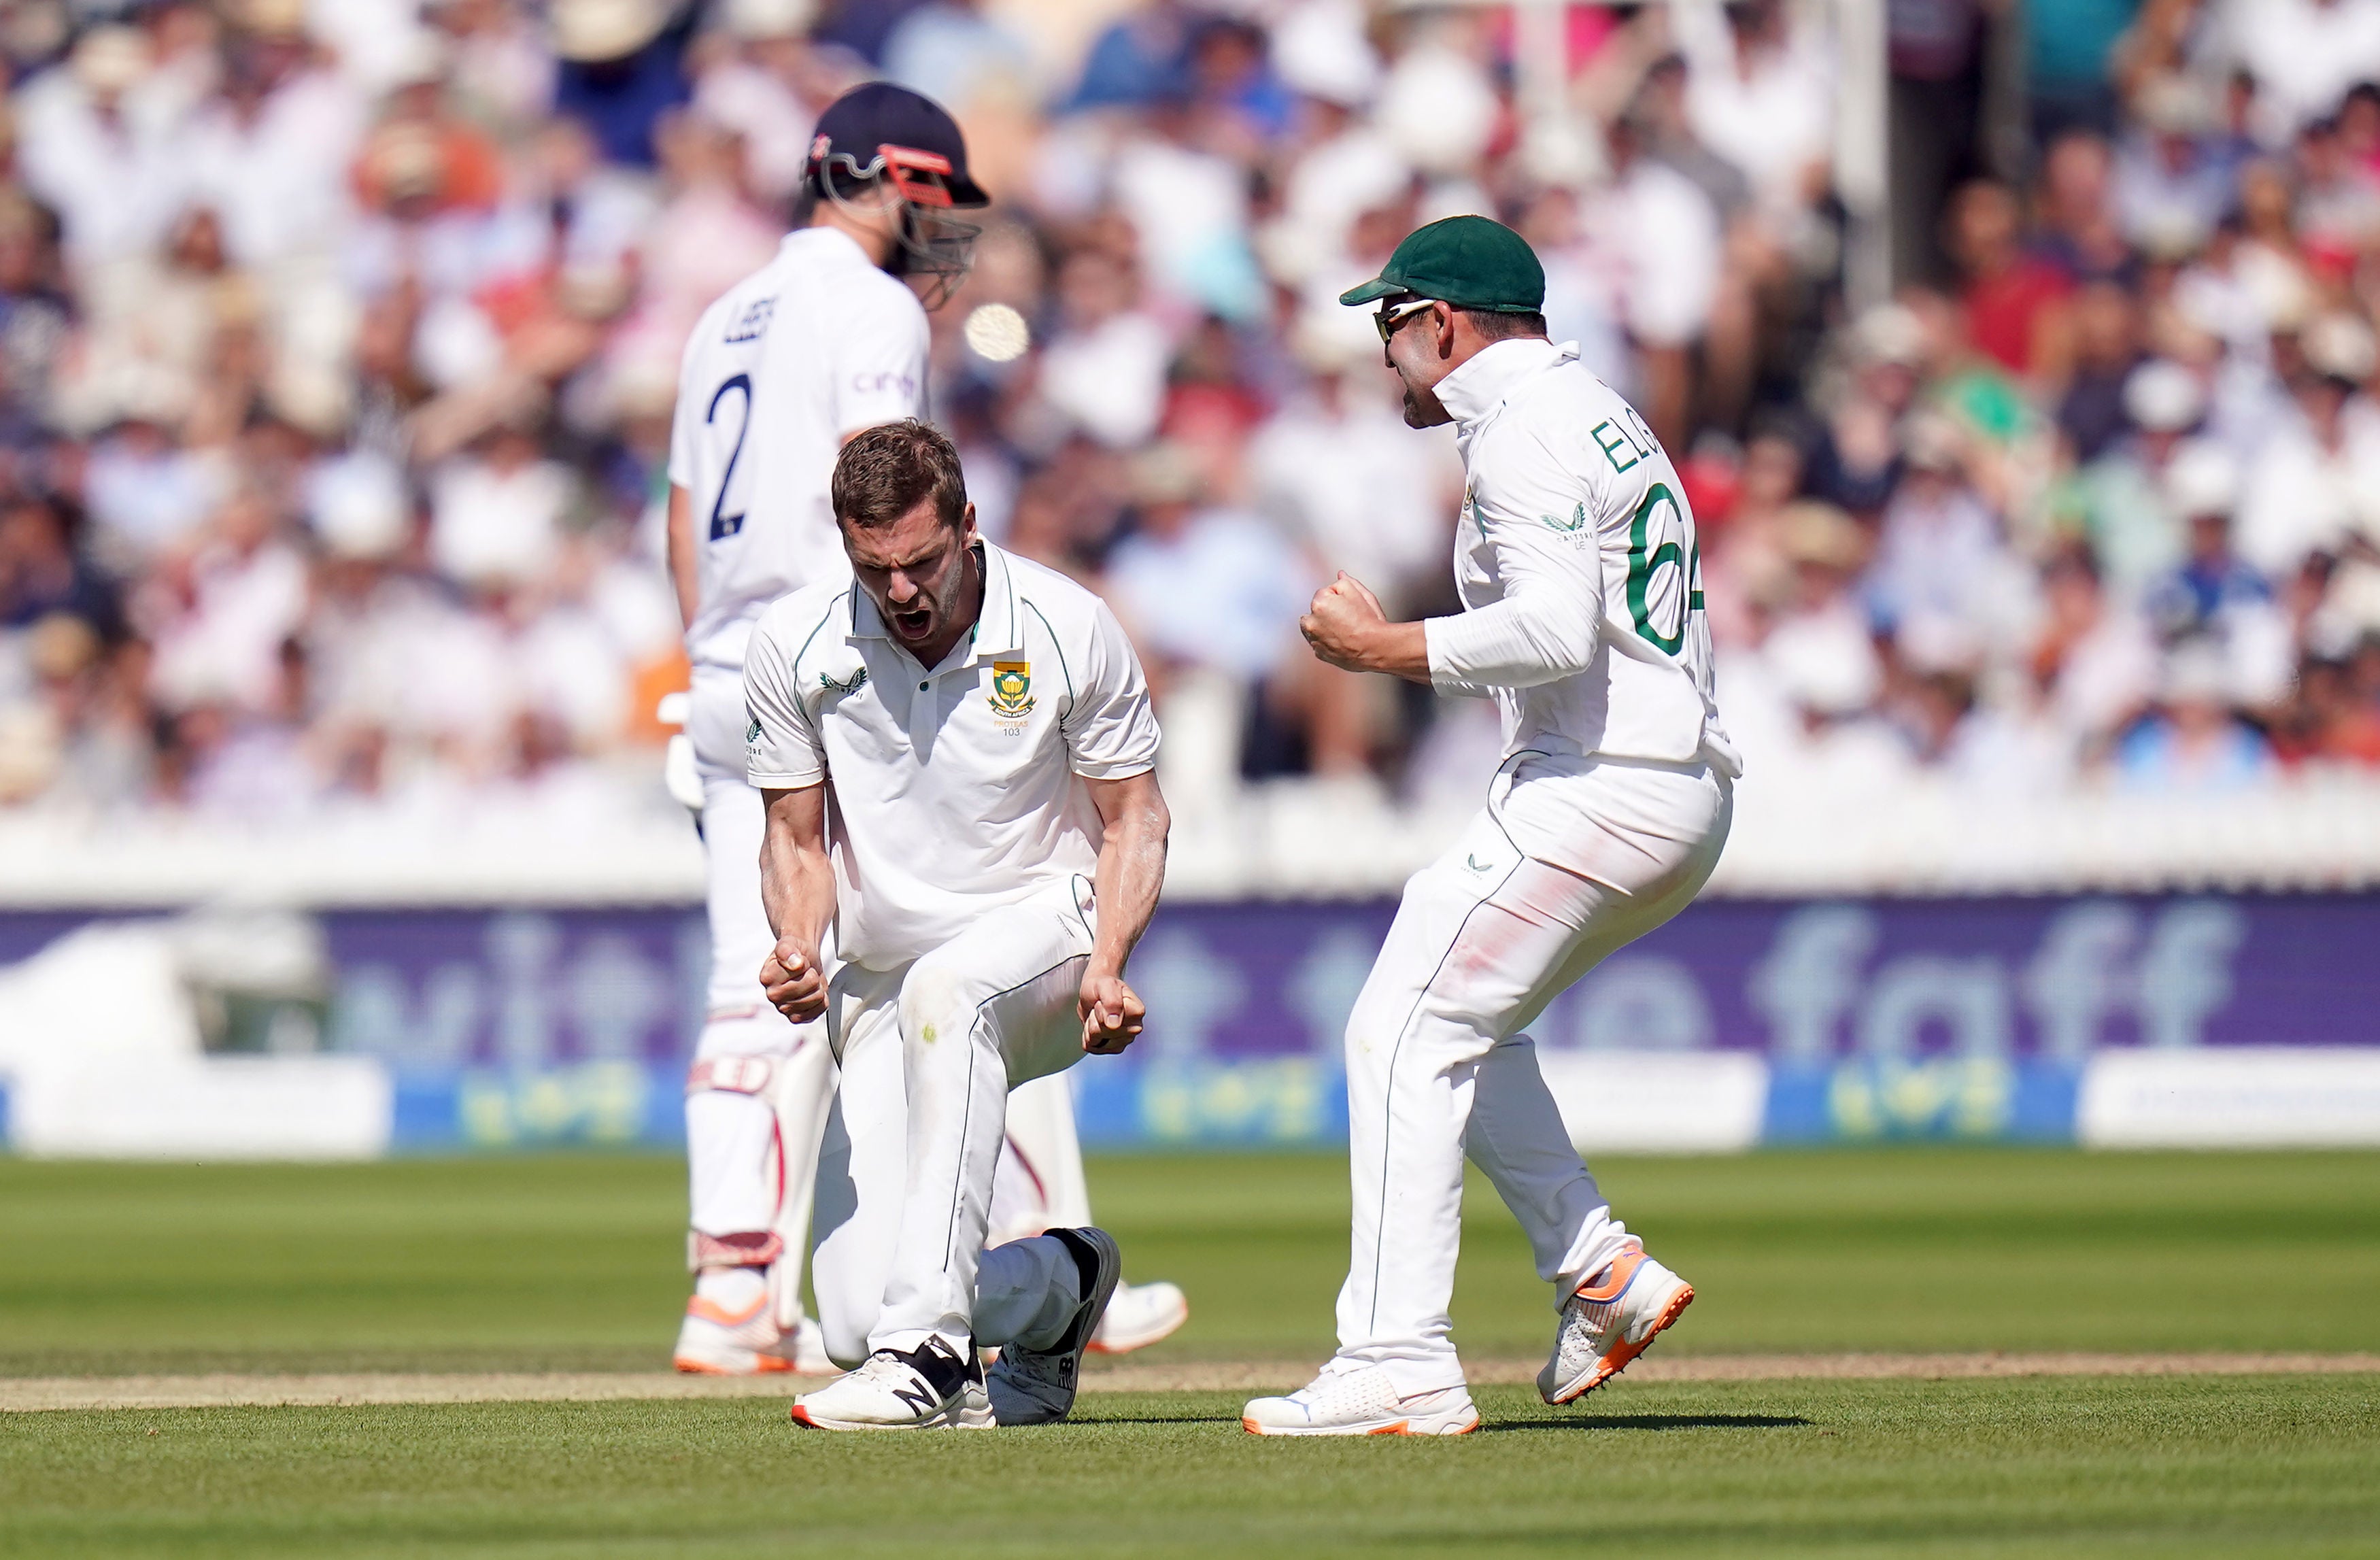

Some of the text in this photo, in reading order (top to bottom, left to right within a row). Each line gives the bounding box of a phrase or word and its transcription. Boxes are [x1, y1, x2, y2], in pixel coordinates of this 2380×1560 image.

[707, 374, 751, 542] 2
[1591, 407, 1661, 474] ELG
[1004, 728, 1020, 736] 103
